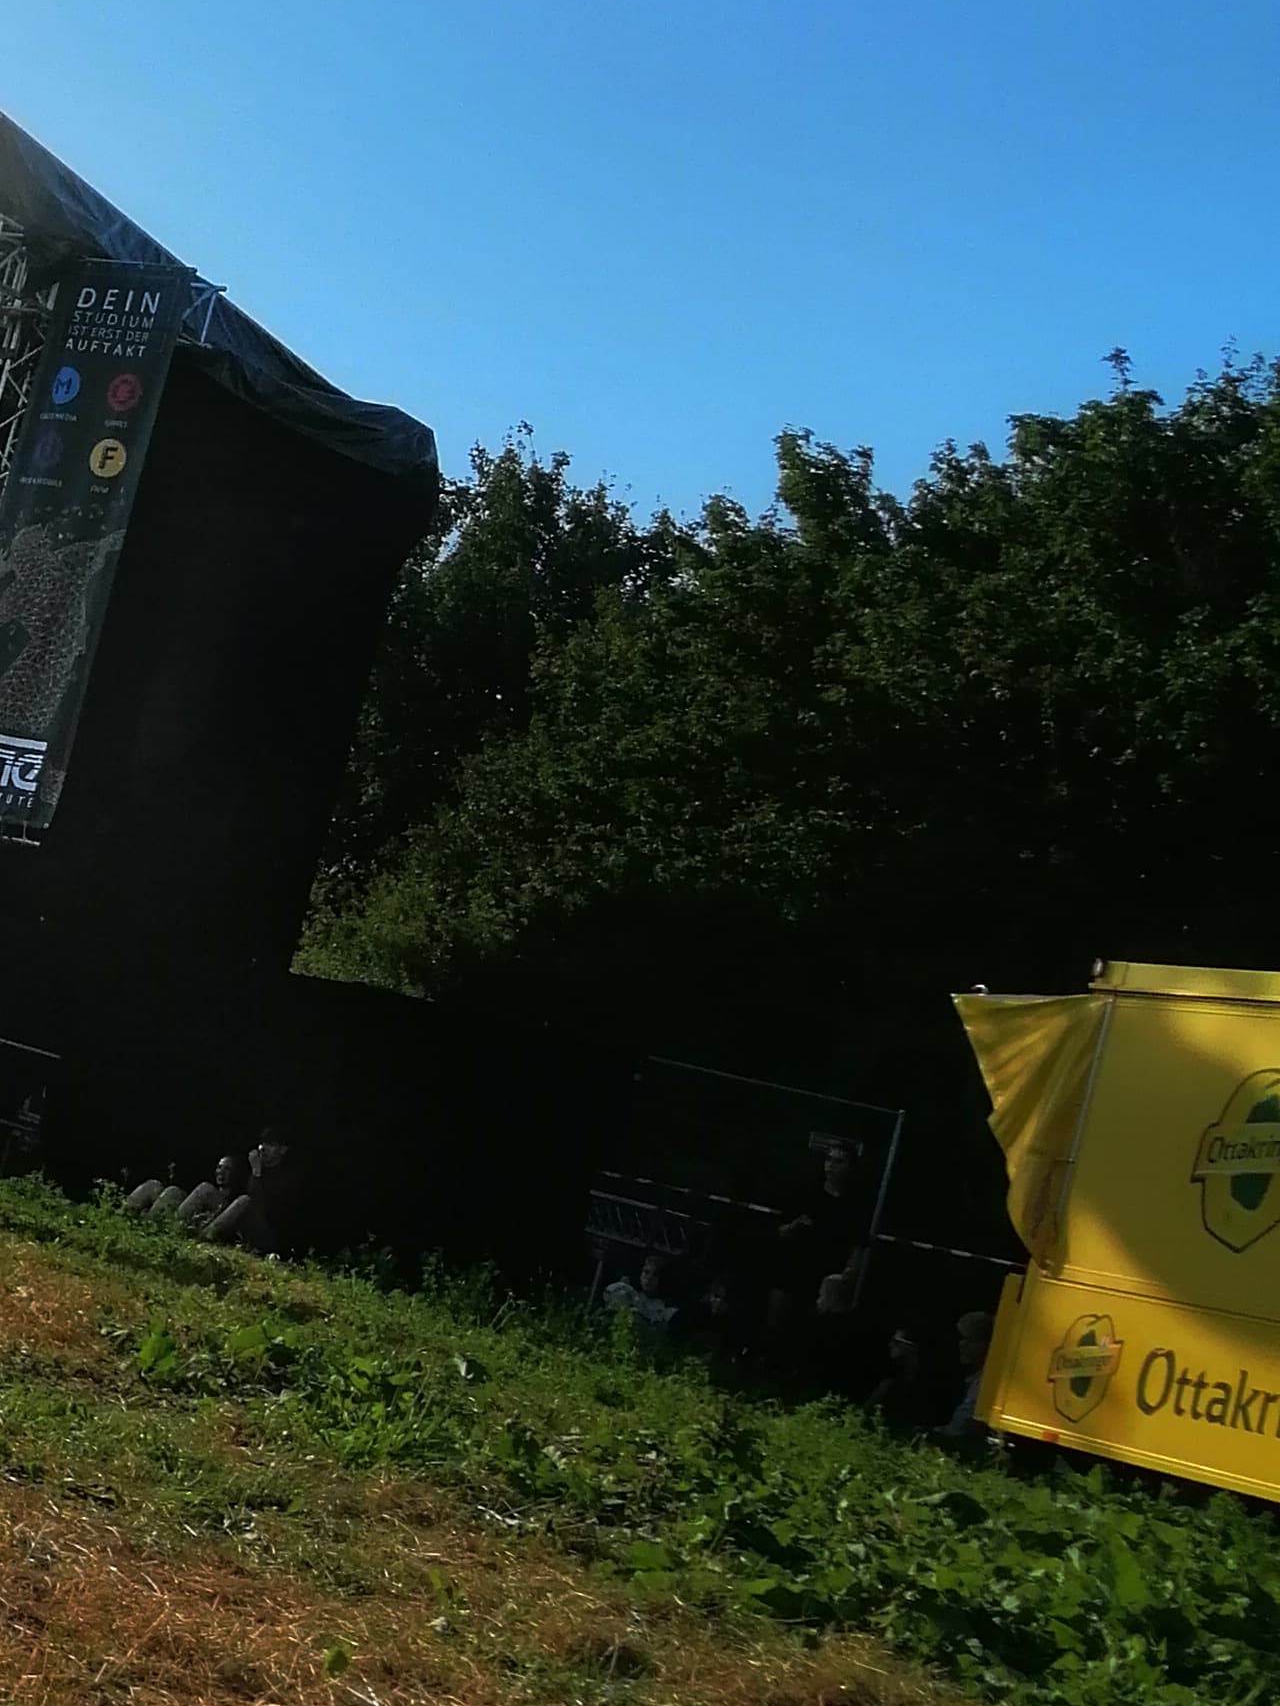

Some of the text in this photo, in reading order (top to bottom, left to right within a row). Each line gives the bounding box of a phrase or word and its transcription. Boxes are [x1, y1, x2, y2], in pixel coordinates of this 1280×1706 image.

[76, 287, 160, 314] DEIN
[72, 310, 155, 329] STUDIUM
[68, 325, 150, 343] IST ERST DER
[65, 337, 147, 357] AUFTAKT
[98, 445, 118, 469] F
